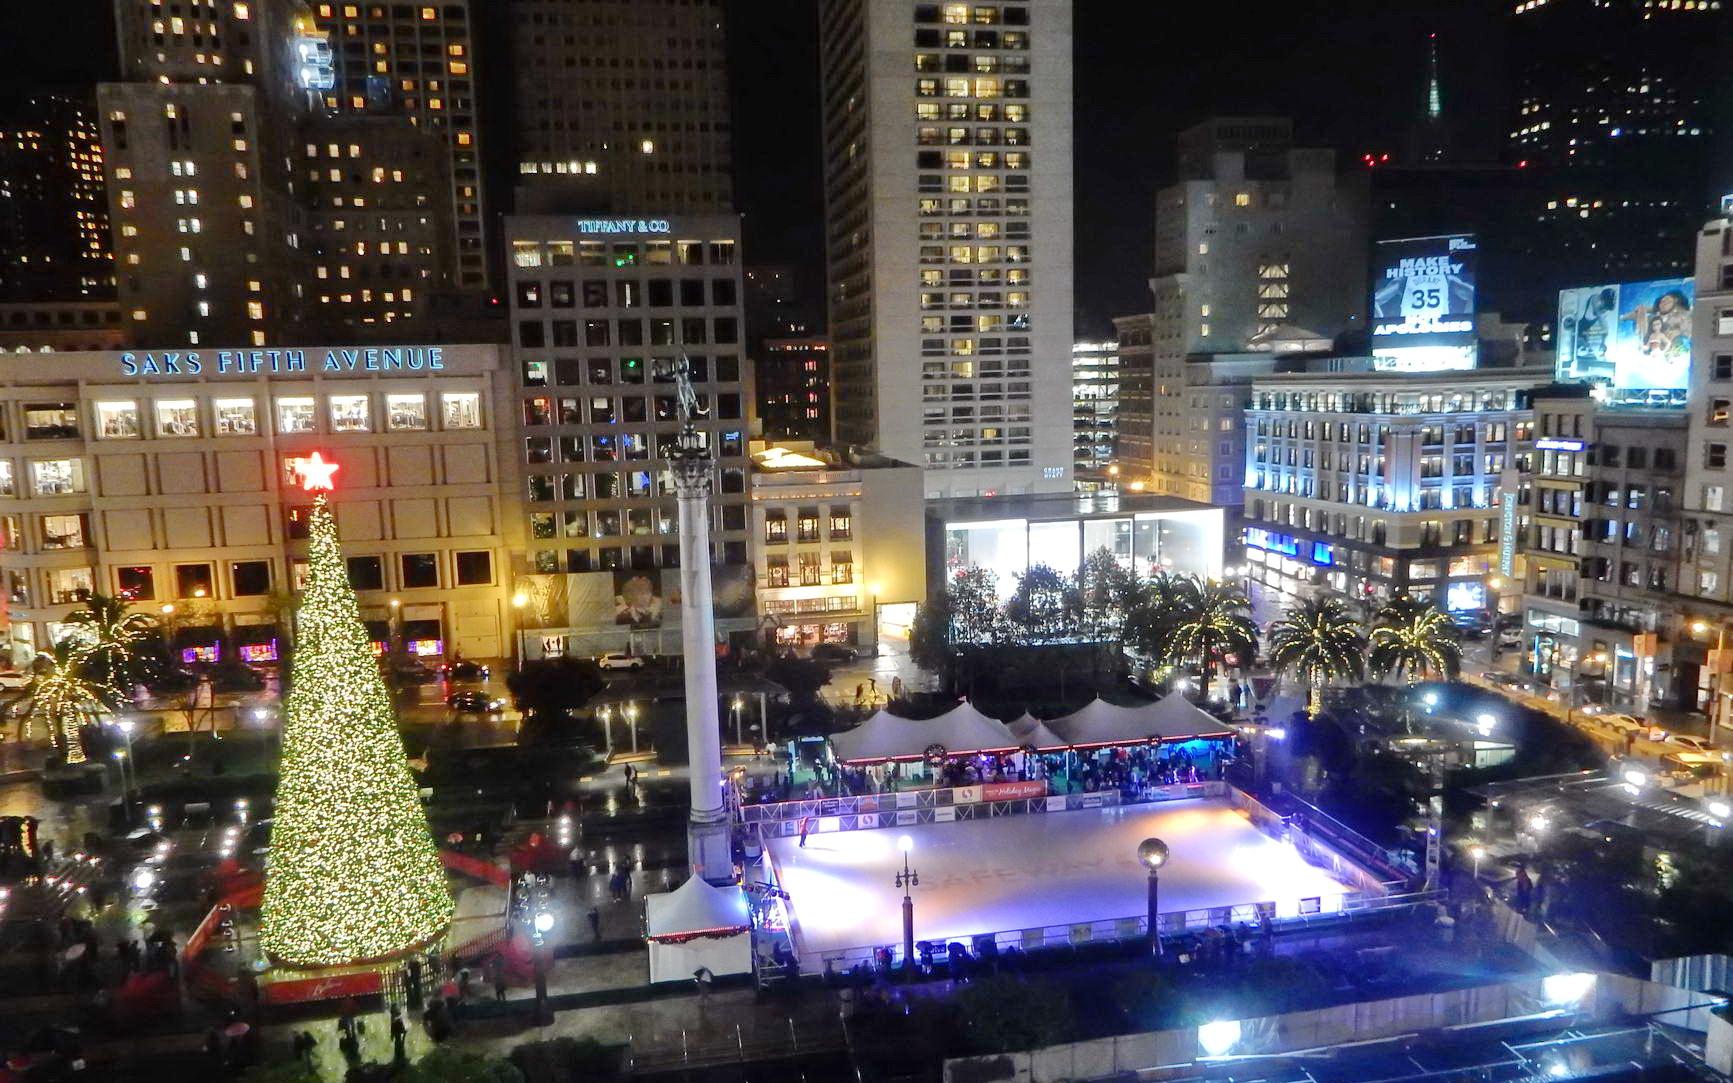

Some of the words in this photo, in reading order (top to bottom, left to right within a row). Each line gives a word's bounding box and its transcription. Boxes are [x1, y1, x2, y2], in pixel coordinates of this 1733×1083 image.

[577, 219, 637, 233] TIFFANY
[637, 219, 649, 233] &
[1386, 263, 1463, 279] HISTORY
[1400, 256, 1449, 270] MAKE
[1411, 288, 1441, 309] 35
[120, 352, 202, 376] SAKS
[218, 350, 306, 374] FIFTH
[323, 348, 444, 371] AVENUE
